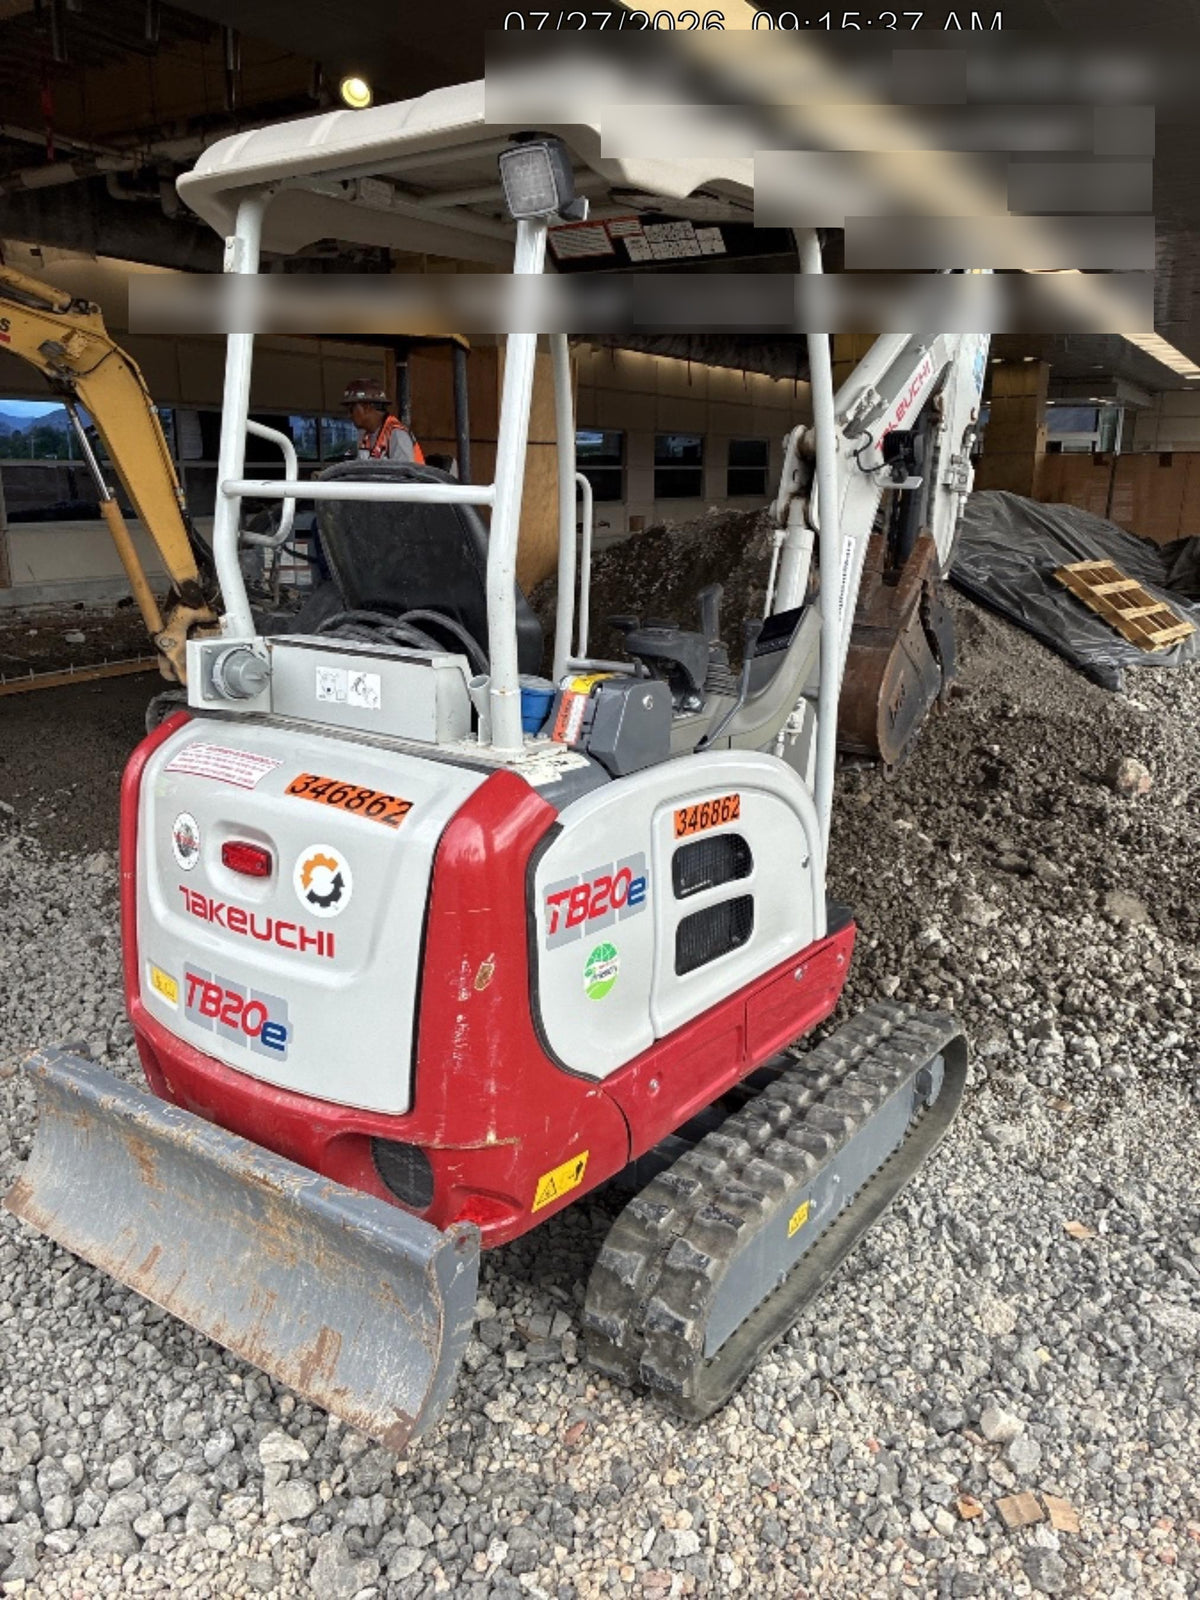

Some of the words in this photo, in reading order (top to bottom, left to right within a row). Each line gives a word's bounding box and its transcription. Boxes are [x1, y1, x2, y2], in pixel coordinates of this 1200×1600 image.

[290, 775, 414, 826] 346862
[676, 794, 740, 836] 346862
[546, 866, 647, 934] TB20e
[184, 971, 288, 1052] TB20e
